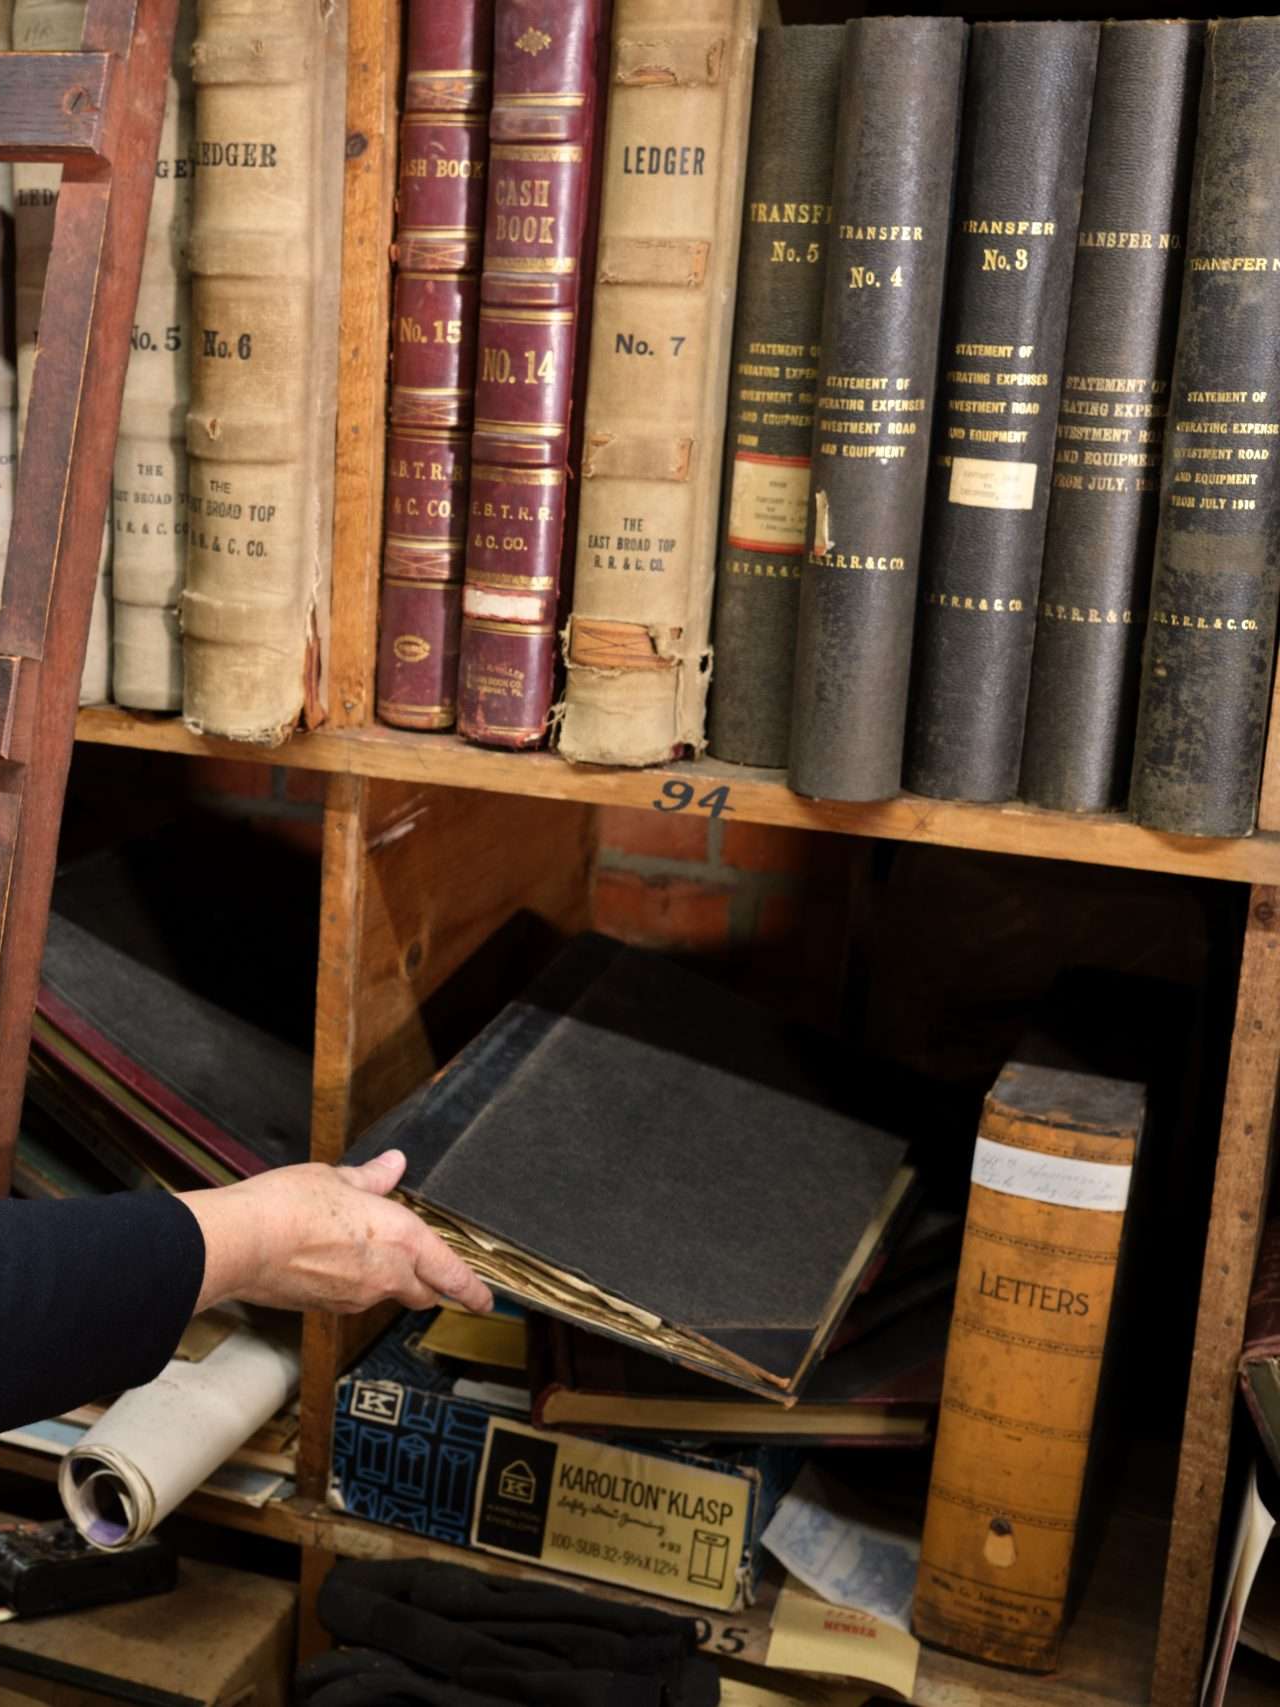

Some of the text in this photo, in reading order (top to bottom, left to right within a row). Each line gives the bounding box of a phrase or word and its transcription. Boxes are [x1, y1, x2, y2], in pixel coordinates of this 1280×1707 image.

[436, 159, 484, 178] BOOK
[624, 146, 705, 176] LEDGER
[17, 188, 58, 207] LED
[495, 180, 550, 207] CASH
[496, 215, 556, 244] BOOK
[839, 225, 924, 241] TRANSFER
[963, 220, 1056, 236] TRANSFER
[1079, 231, 1153, 249] RANSFER
[771, 241, 820, 263] No. 5
[982, 248, 1029, 271] No. 3
[849, 265, 904, 289] No. 4
[165, 326, 182, 352] 5
[400, 317, 462, 344] No. 15
[238, 333, 252, 360] 6
[615, 333, 686, 357] No. 7
[956, 344, 1034, 358] STATEMENT OF
[482, 348, 557, 385] NO. 14
[826, 376, 911, 391] STATEMENT OF
[1066, 376, 1146, 392] STATEMENT
[1187, 391, 1267, 403] STATEMENT OF
[970, 429, 1029, 443] EQUIPMENT
[1232, 423, 1280, 435] EXPENSE
[842, 444, 907, 458] EQUIPMENT
[1084, 451, 1148, 467] EQUIPME
[1238, 449, 1269, 460] ROAD
[137, 463, 163, 477] THE
[1195, 473, 1258, 485] EQUIPMENT
[210, 479, 232, 495] THE
[248, 504, 276, 522] TOP
[427, 500, 455, 518] CO.
[623, 517, 643, 533] THE
[247, 540, 268, 557] CO.
[503, 537, 528, 551] CO.
[588, 534, 677, 553] EAST BROAD TOP
[653, 780, 736, 818] 94
[978, 1269, 1089, 1317] LETTERS
[358, 1391, 395, 1416] K
[505, 1478, 529, 1497] K
[667, 1491, 733, 1526] KLASP
